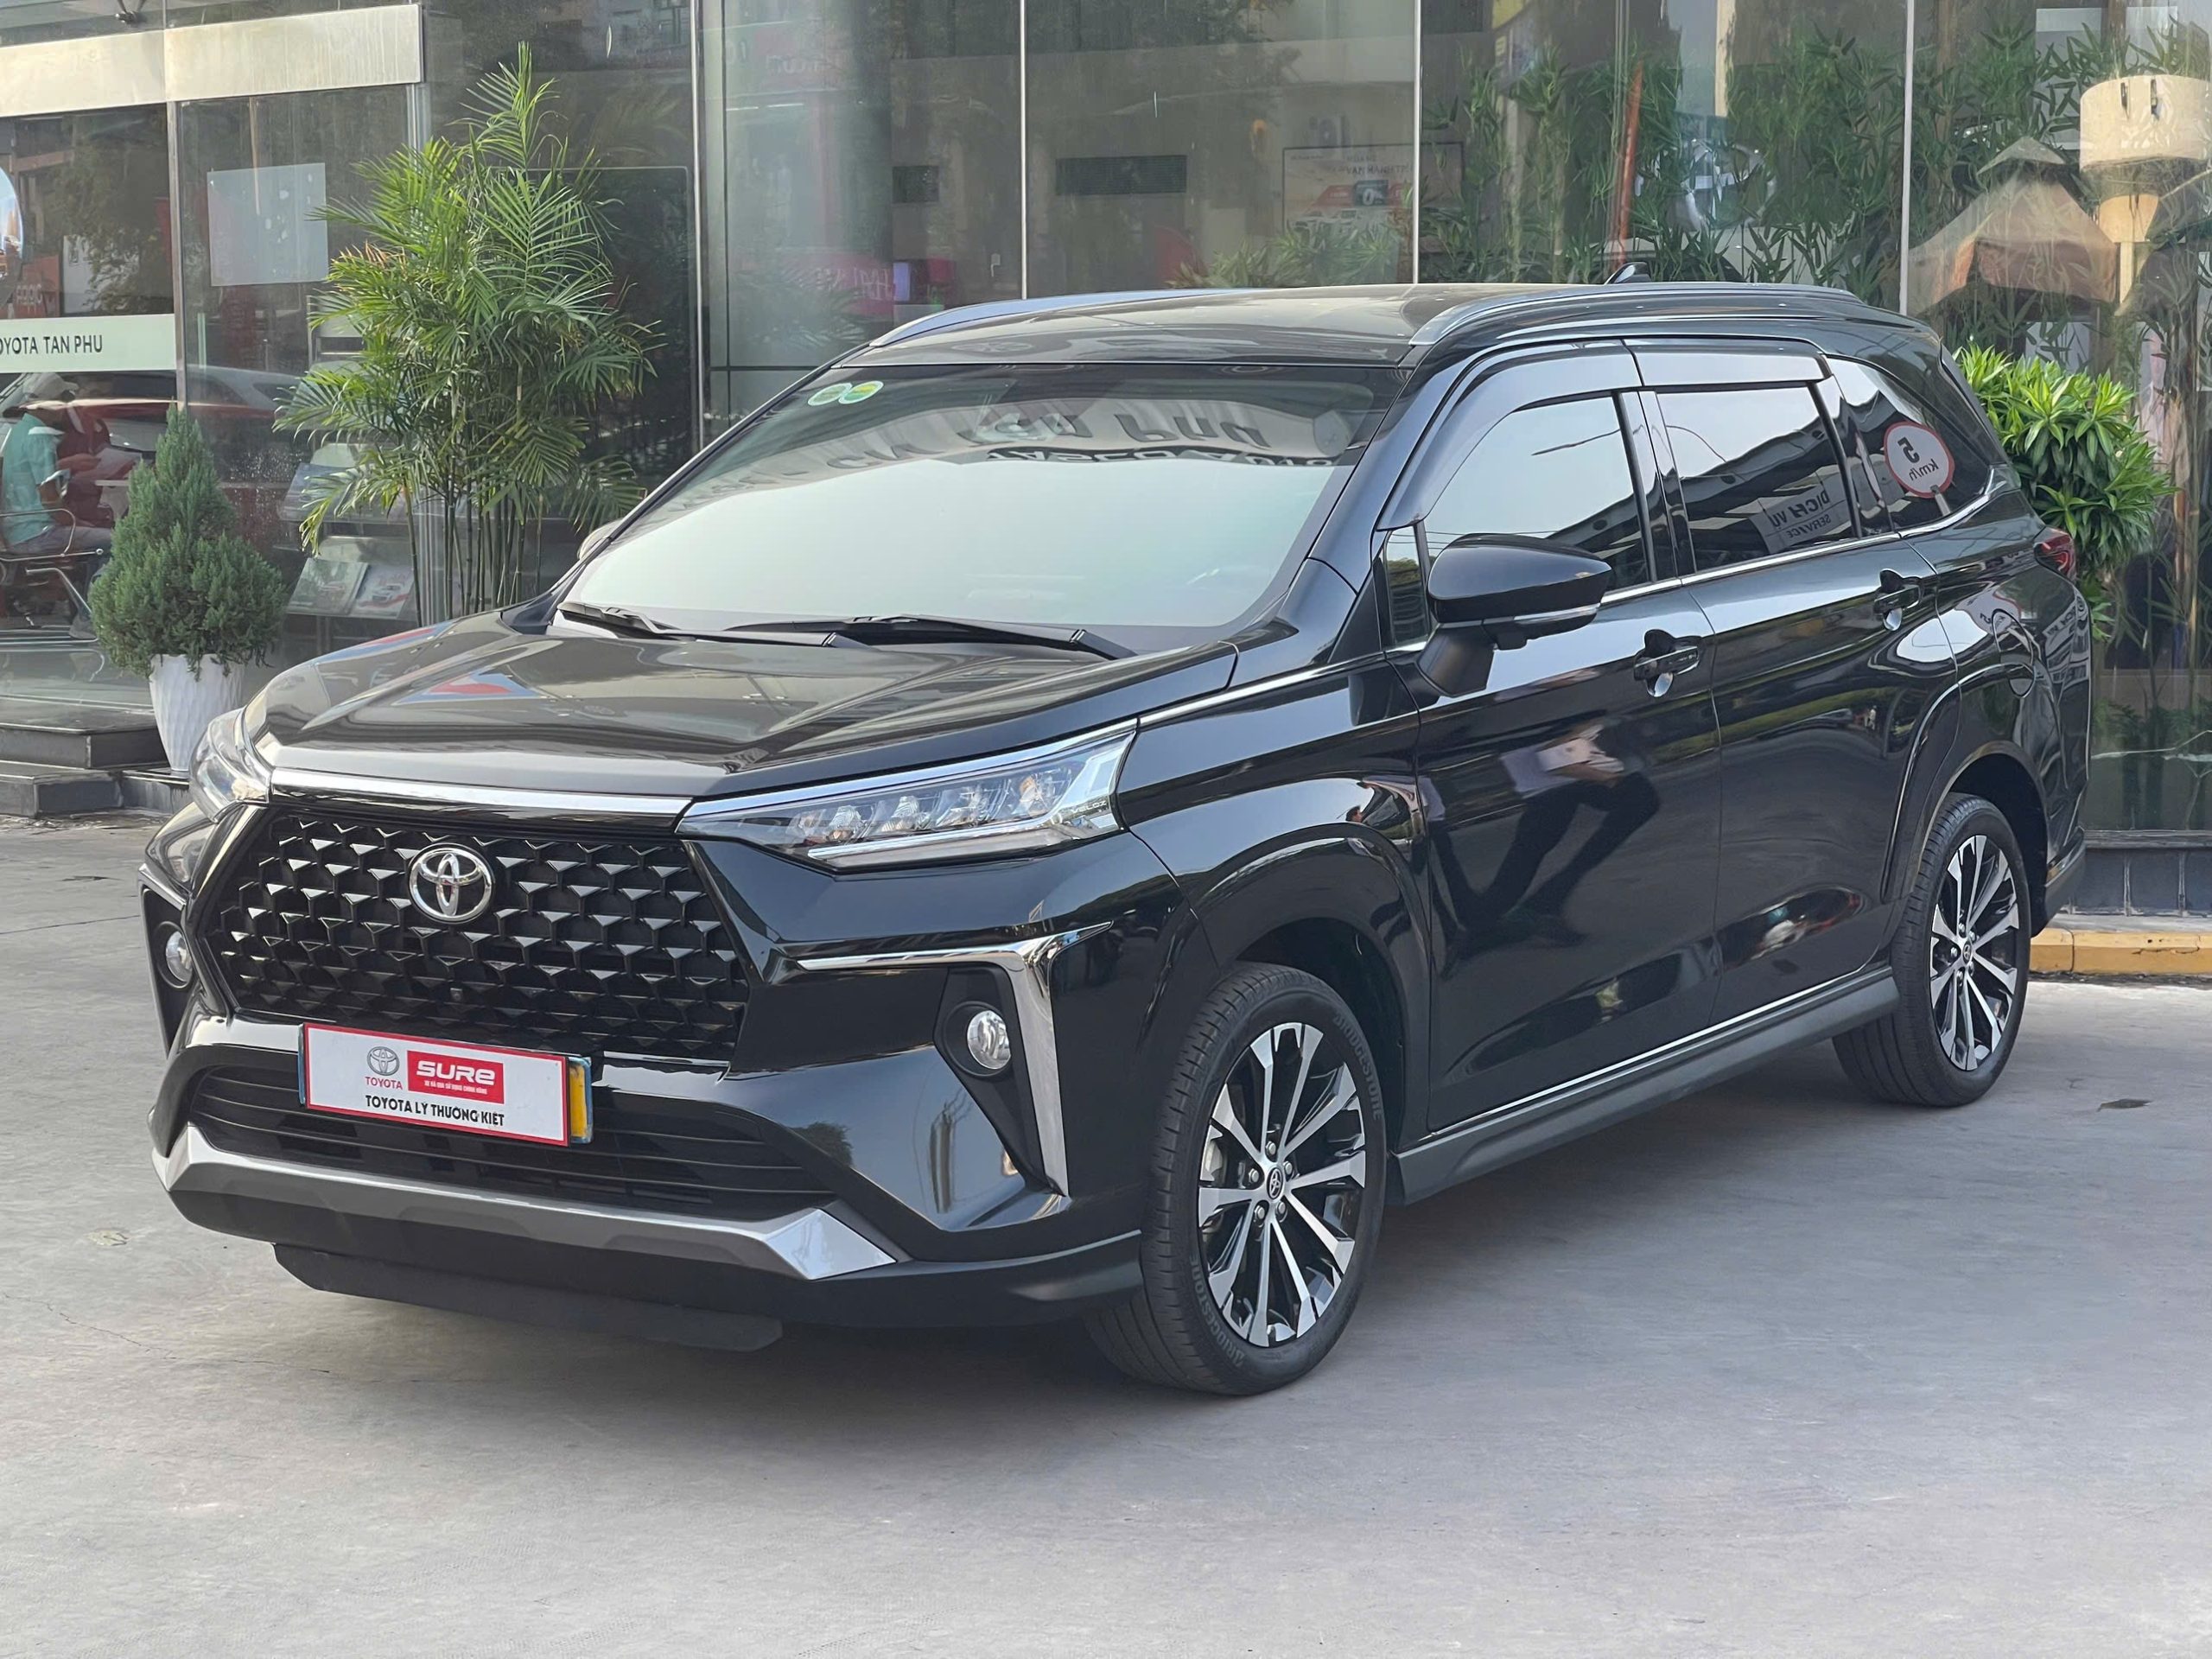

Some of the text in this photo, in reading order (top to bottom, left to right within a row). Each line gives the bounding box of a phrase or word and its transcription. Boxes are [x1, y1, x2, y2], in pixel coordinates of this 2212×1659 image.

[43, 335, 70, 354] TAN
[74, 334, 103, 353] PHU
[1071, 800, 1107, 813] VELOZ
[365, 1077, 404, 1090] TOYOTA
[365, 1095, 412, 1113] TOYOTA
[1189, 1254, 1245, 1368] BRIDGESTONE
